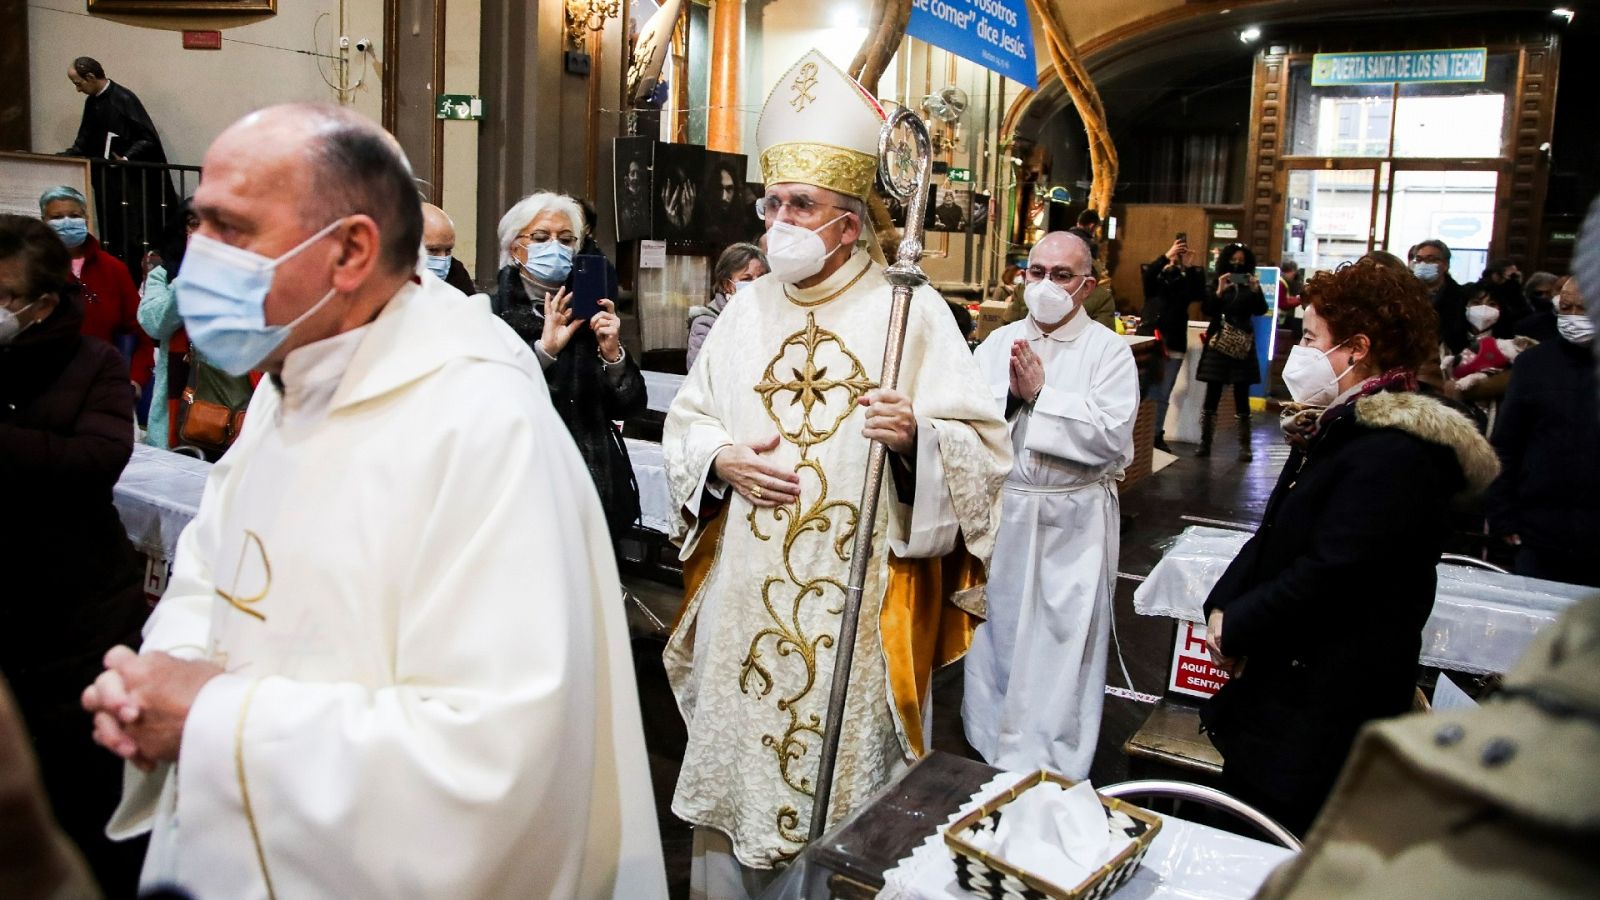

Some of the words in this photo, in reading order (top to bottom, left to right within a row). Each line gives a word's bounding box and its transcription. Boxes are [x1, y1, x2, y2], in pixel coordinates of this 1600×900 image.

[977, 16, 999, 46] dice
[999, 28, 1027, 60] Jesús.
[1331, 56, 1366, 80] PUERTA
[1366, 55, 1396, 79] SANTA
[1398, 54, 1411, 78] DE
[1411, 54, 1431, 78] LOS
[1432, 53, 1449, 77] SIN
[1450, 52, 1483, 77] TECHO
[1181, 661, 1207, 674] AQUÍ
